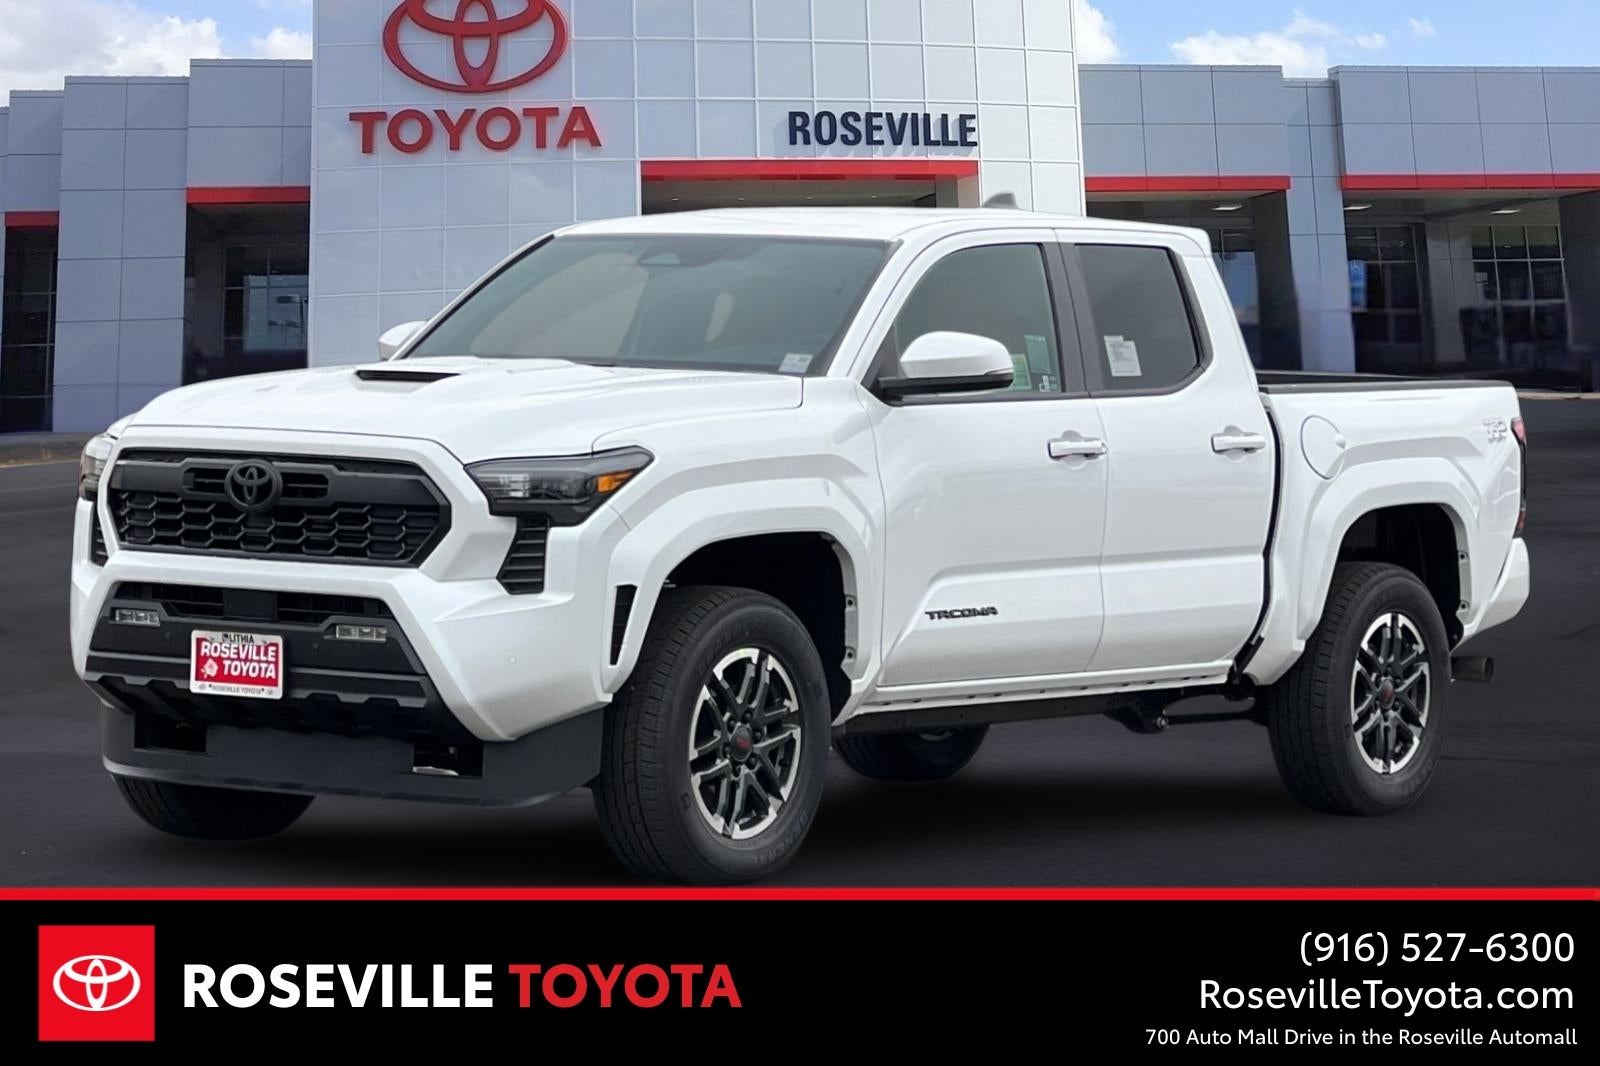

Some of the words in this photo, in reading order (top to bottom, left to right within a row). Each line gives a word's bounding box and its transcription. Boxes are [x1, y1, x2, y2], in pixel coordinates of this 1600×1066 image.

[350, 106, 602, 154] TOYOTA
[789, 111, 978, 147] ROSEVILLE
[925, 606, 998, 621] TACOMA
[229, 634, 255, 644] LITHIA
[200, 642, 277, 662] ROSEVILLE
[223, 660, 276, 680] TOYOTA
